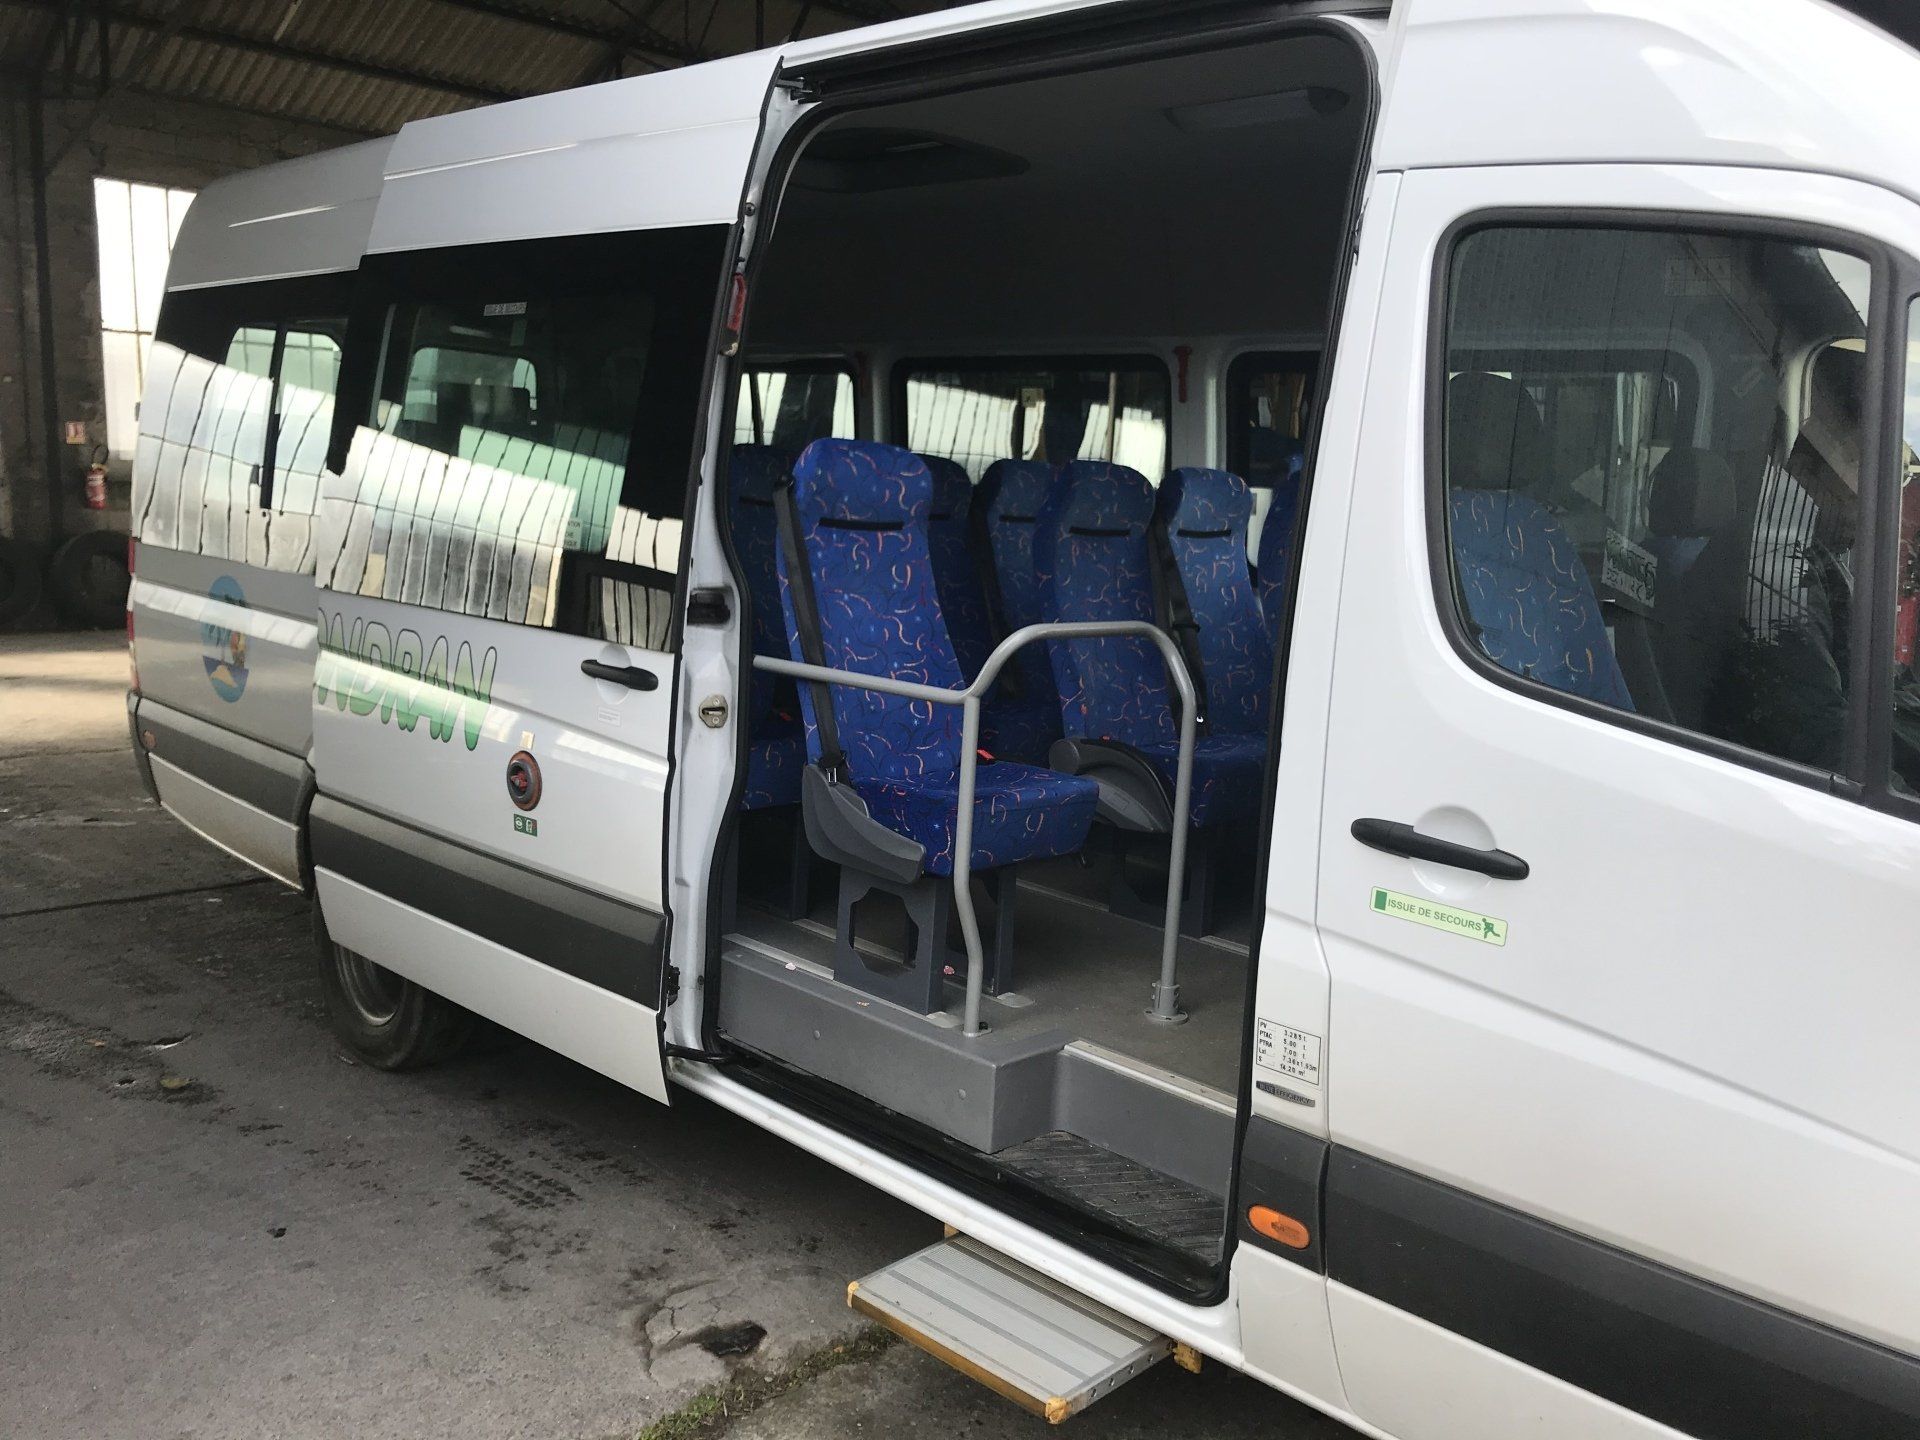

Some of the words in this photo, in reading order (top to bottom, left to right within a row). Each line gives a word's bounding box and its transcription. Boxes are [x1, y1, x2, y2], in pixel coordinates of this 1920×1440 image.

[1388, 898, 1416, 914] ISSUE
[1418, 907, 1432, 918] DE
[1434, 911, 1482, 931] SECOURS
[1260, 1030, 1273, 1040] PTAC
[1259, 1038, 1273, 1048] PTRA
